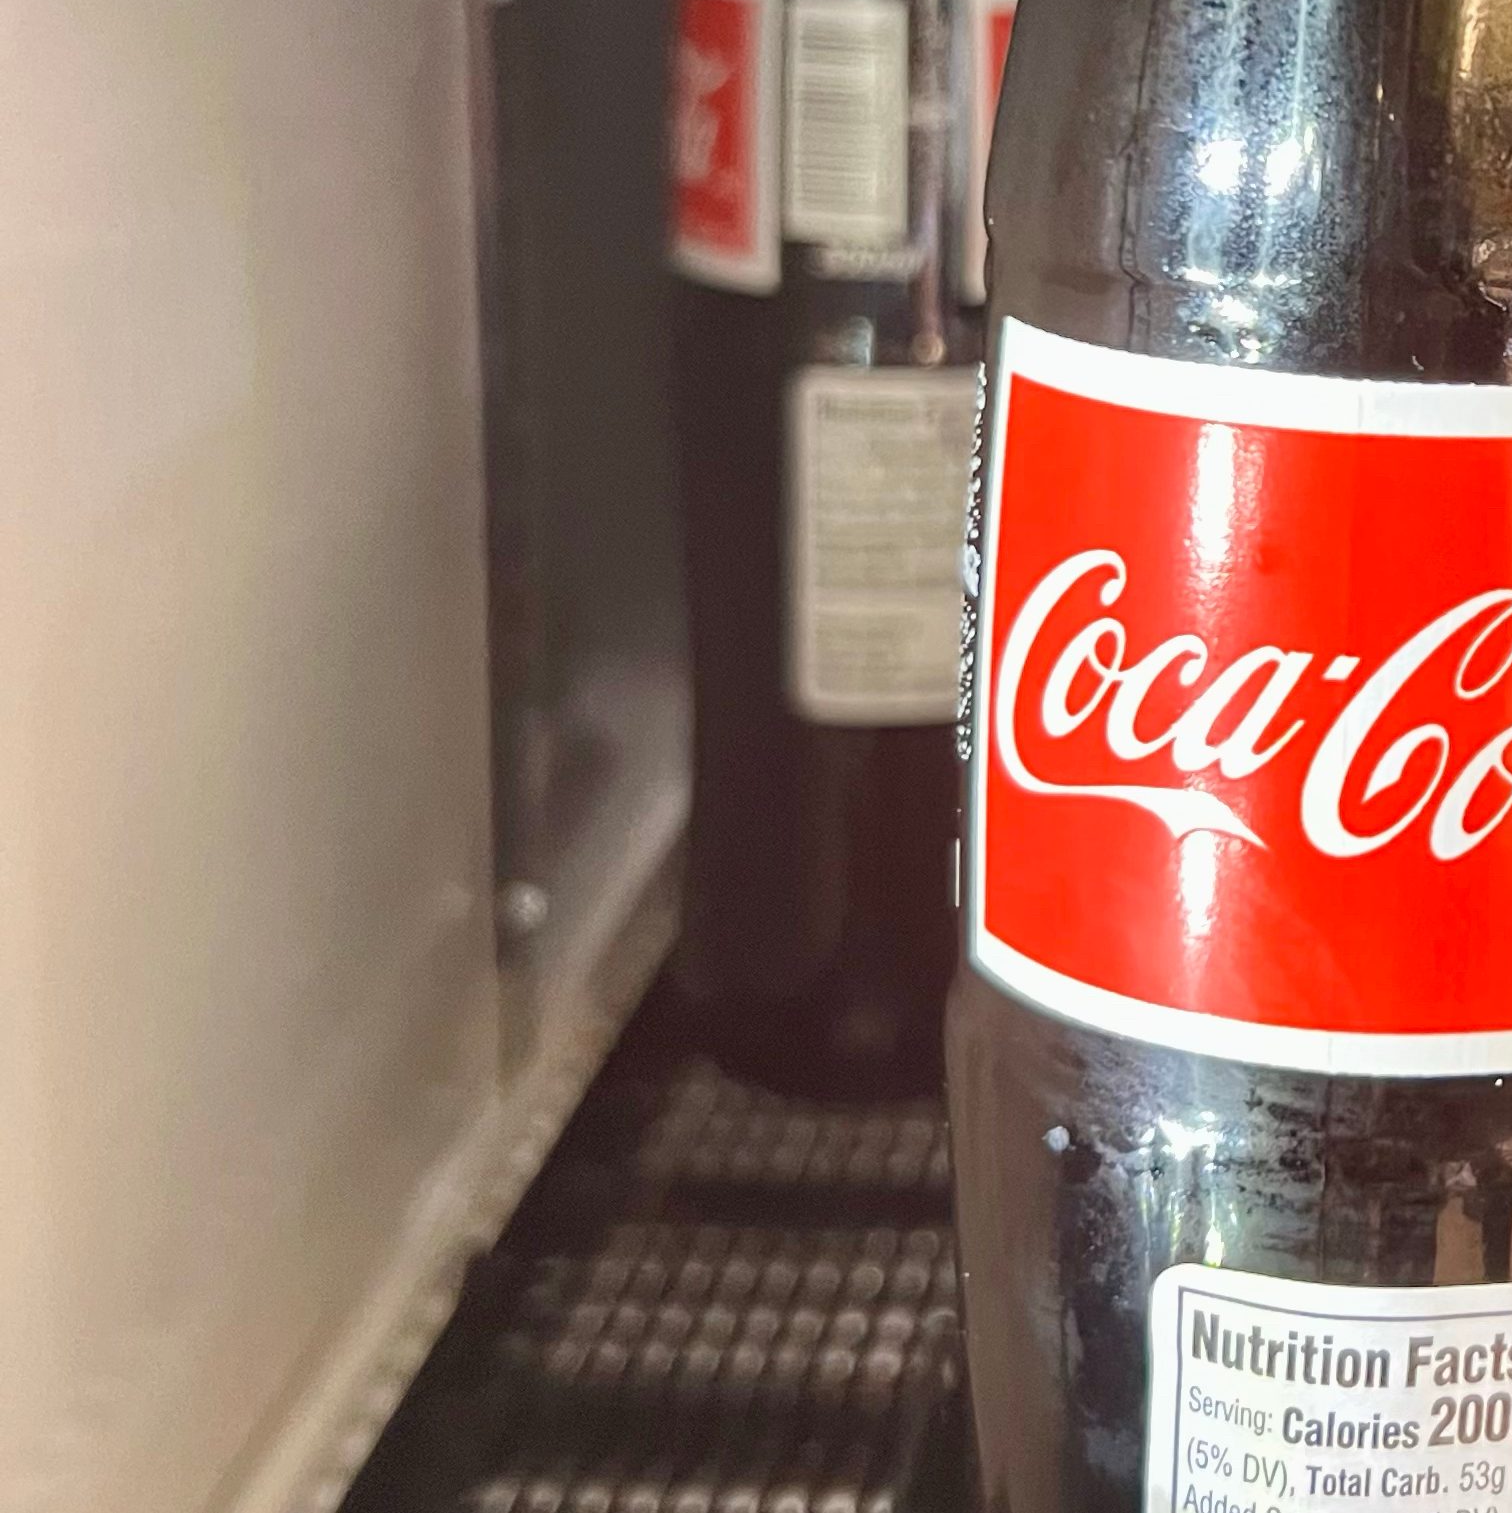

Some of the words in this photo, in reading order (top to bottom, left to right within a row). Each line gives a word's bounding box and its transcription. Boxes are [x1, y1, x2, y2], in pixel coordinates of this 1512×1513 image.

[1191, 1309, 1392, 1389] Nutrition
[1188, 1385, 1274, 1437] Serving:
[1281, 1406, 1421, 1450] Calories
[1187, 1436, 1233, 1478] (5%
[1242, 1452, 1296, 1499] DV),
[1305, 1464, 1372, 1498] Total
[1381, 1465, 1449, 1498] Carb.
[1459, 1460, 1506, 1496] 53g
